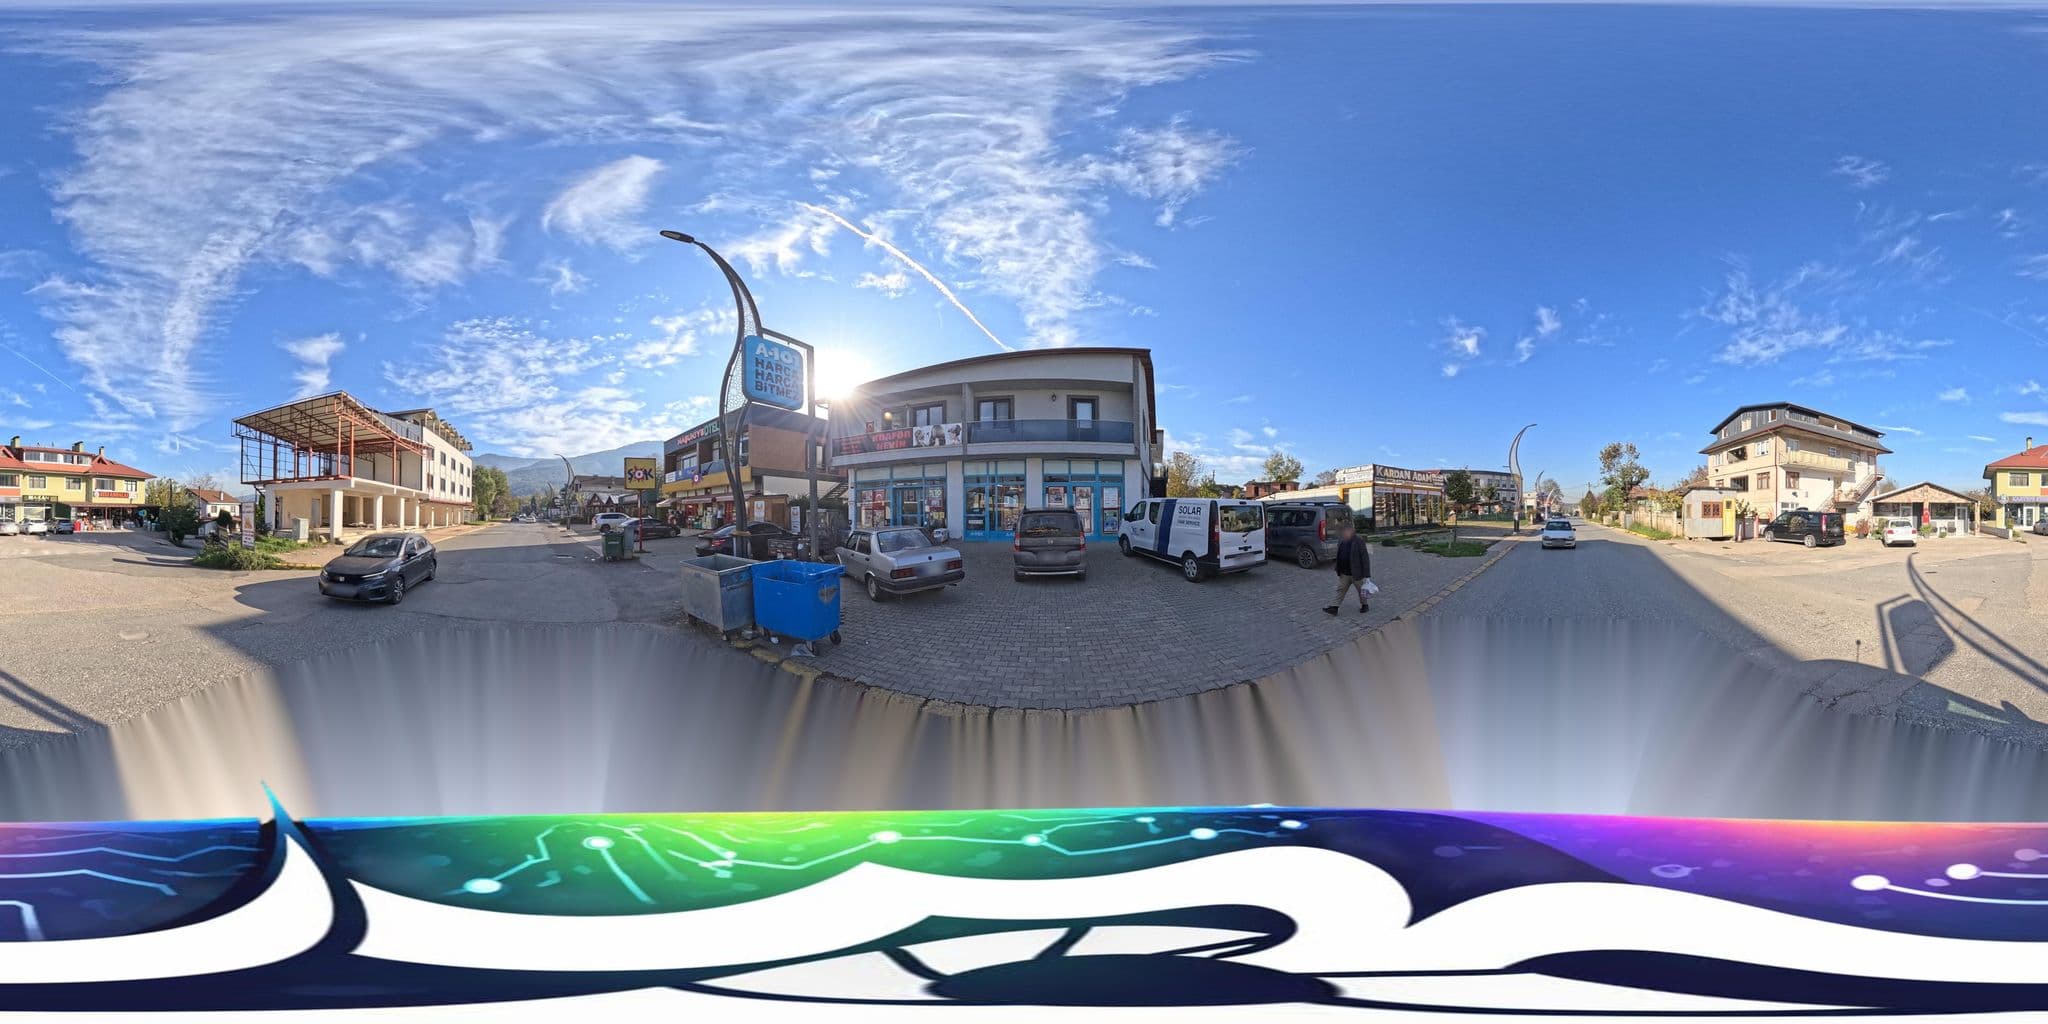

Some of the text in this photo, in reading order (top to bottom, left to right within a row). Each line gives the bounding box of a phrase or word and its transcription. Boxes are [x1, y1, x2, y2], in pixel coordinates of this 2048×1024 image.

[1376, 465, 1411, 480] KARDAN
[1412, 471, 1434, 483] ADAM
[1178, 505, 1202, 516] SOLAR
